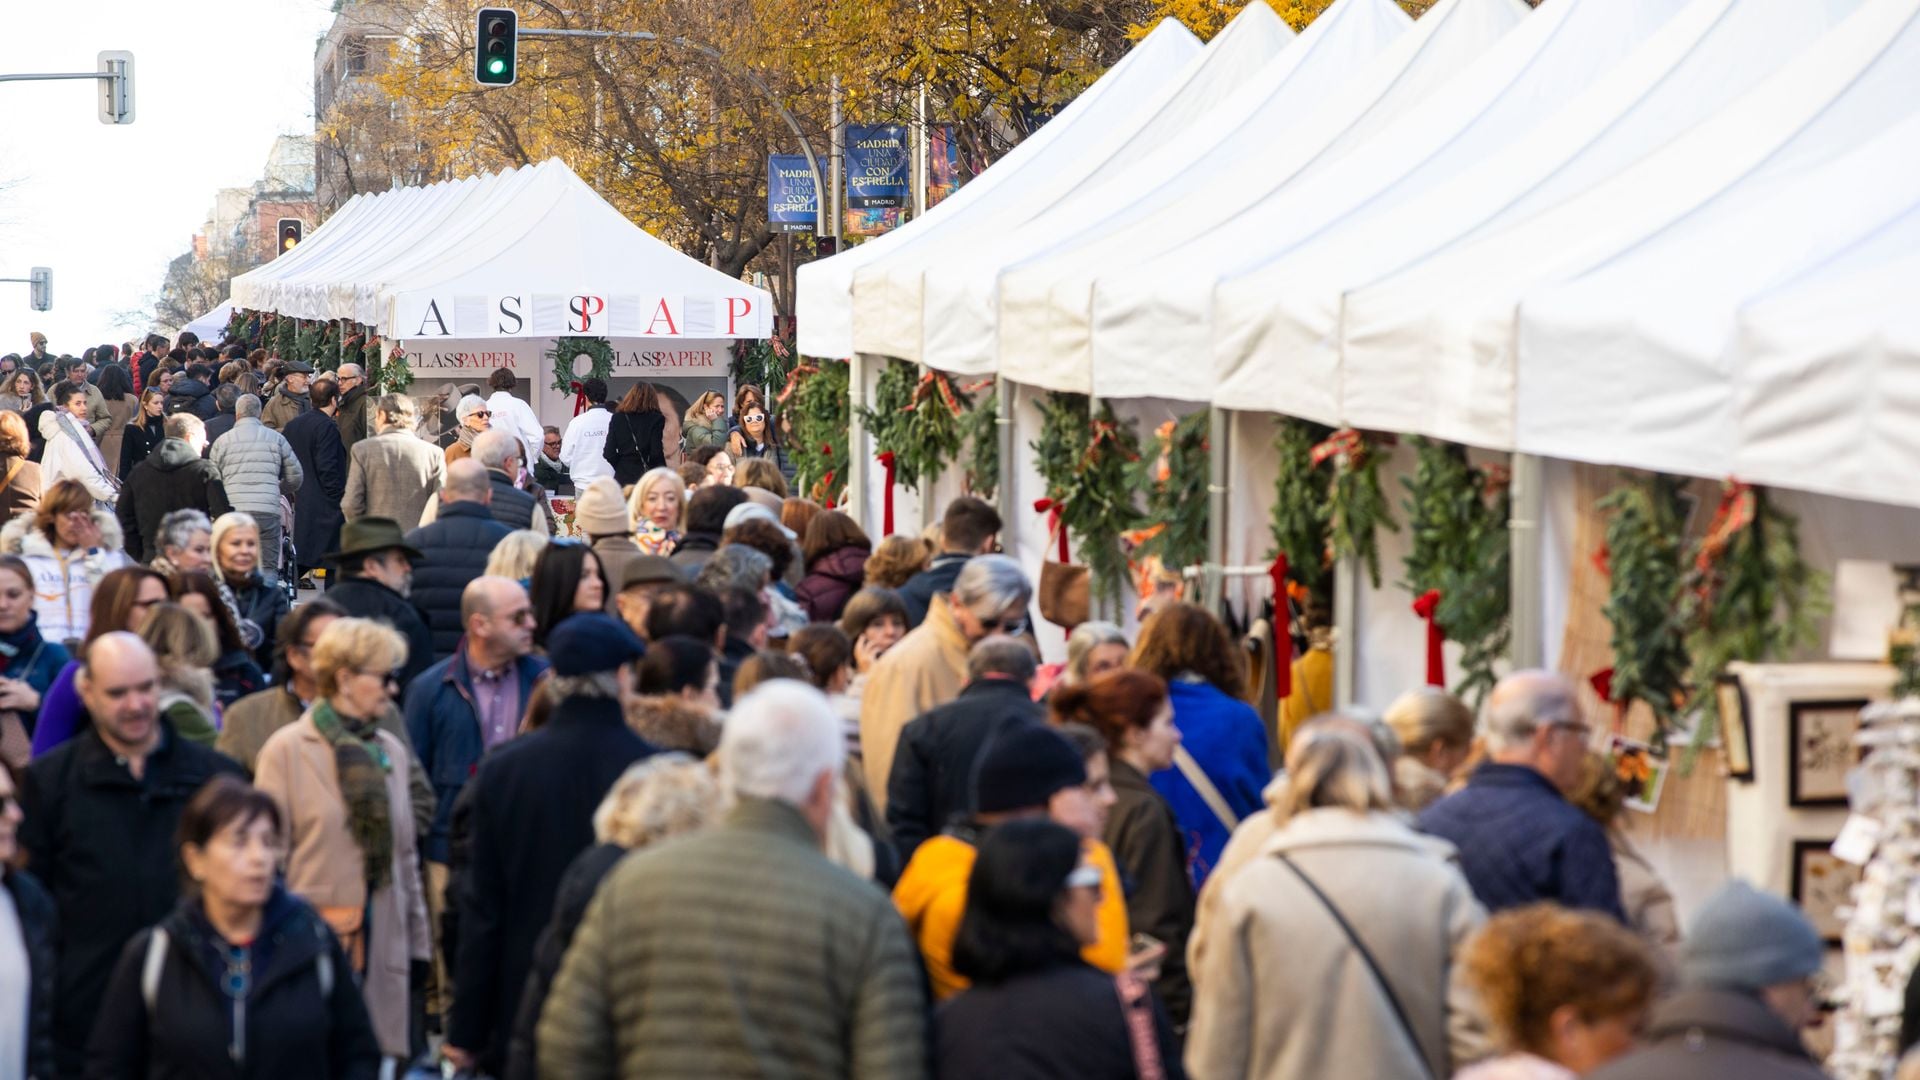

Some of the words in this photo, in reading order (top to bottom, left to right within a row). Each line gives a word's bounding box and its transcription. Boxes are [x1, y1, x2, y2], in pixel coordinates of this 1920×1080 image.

[857, 139, 899, 149] MADRID
[868, 149, 891, 157] UNA
[780, 169, 814, 178] MADRI
[865, 167, 890, 176] CON
[790, 178, 811, 186] UNA
[852, 176, 905, 187] ESTRELLA
[786, 195, 809, 203] CON
[773, 203, 819, 213] ESTRELL
[415, 298, 451, 336] A
[498, 296, 523, 335] S
[643, 297, 681, 335] A
[724, 297, 752, 335] P
[614, 351, 713, 367] LASSPAPER
